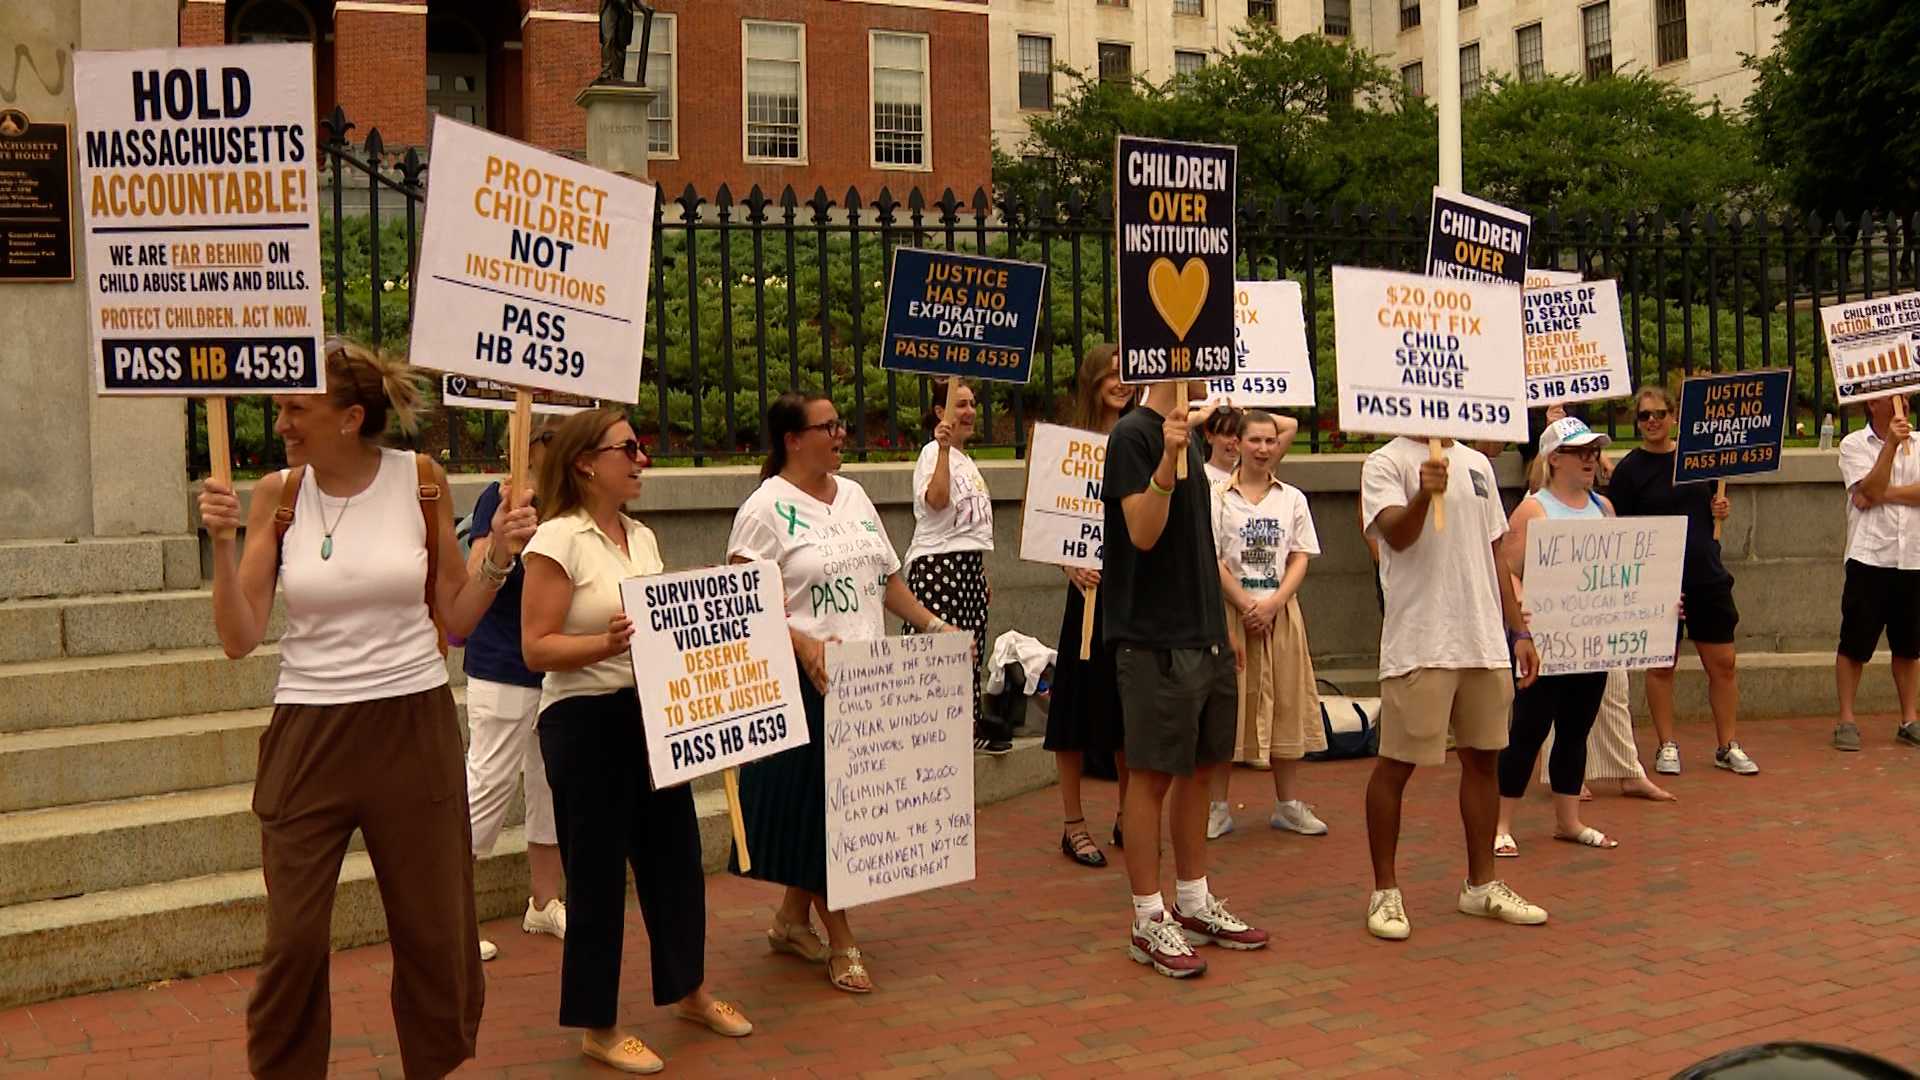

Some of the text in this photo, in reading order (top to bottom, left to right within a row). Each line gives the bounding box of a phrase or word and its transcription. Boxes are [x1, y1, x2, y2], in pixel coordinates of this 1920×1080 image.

[132, 67, 251, 121] HOLD
[86, 125, 304, 168] MASSACHUSETTS
[1128, 151, 1227, 192] CHILDREN
[91, 170, 307, 217] ACCOUNTABLE!
[485, 155, 609, 217] PROTECT
[474, 187, 610, 250] CHILDREN
[1149, 191, 1207, 224] OVER
[1125, 223, 1229, 255] INSTITUTIONS
[1440, 209, 1522, 254] CHILDREN
[110, 242, 289, 266] WE ARE FAR BEHIND ON
[510, 229, 573, 272] NOT
[1455, 241, 1504, 274] OVER
[99, 270, 309, 293] CHILD ABUSE LAWS AND BILLS.
[465, 253, 607, 306] INSTITUTIONS
[925, 263, 1009, 289] JUSTICE
[926, 284, 1006, 311] HAS NO
[1387, 286, 1472, 311] $20,000
[1524, 288, 1596, 308] IVORS OF
[1540, 302, 1597, 320] SEXUAL
[1843, 303, 1891, 320] CHILDREN
[101, 305, 311, 329] PROTECT CHILDREN. ACT NOW.
[502, 303, 566, 343] PASS
[908, 301, 1019, 328] EXPIRATION
[1377, 309, 1482, 336] CAN'T FIX
[1526, 317, 1582, 335] OLENCE
[1877, 315, 1895, 327] NOT
[938, 321, 985, 341] DATE
[1403, 331, 1460, 350] CHILD
[1528, 331, 1580, 348] ESERVE
[115, 345, 304, 380] PASS HB 4539
[475, 332, 585, 378] HB 4539
[895, 340, 1020, 369] PASS HB 4539
[1128, 348, 1166, 377] PASS
[1171, 347, 1190, 373] HB
[1195, 345, 1230, 371] 4539
[1395, 350, 1469, 371] SEXUAL
[1562, 342, 1597, 358] LIMIT
[1402, 370, 1464, 389] ABUSE
[1527, 355, 1608, 376] EEK JUSTICE
[1210, 377, 1287, 393] HB 4539
[1544, 381, 1565, 398] HB
[1570, 375, 1610, 394] 4539
[1706, 381, 1765, 404] JUSTICE
[1357, 396, 1510, 424] PASS HB 4539
[1705, 400, 1763, 419] HAS NO
[1692, 413, 1772, 437] EXPIRATION
[1714, 431, 1748, 447] DATE
[1068, 440, 1105, 462] PRO
[1684, 447, 1773, 471] PASS HB 4539
[1061, 459, 1103, 480] CHIL
[1056, 495, 1104, 514] INSTIT
[1081, 523, 1101, 541] PA
[1063, 540, 1087, 558] HB
[1538, 535, 1566, 566] WE
[1633, 531, 1658, 559] BE
[645, 570, 761, 608] SURVIVORS OF
[1577, 563, 1646, 592] SILENT
[811, 577, 859, 618] PASS
[1534, 591, 1639, 614] SO YOU CAN BE
[650, 593, 764, 632] CHILD SEXUAL
[673, 617, 751, 652] VIOLENCE
[870, 635, 934, 658] HB 4539
[1535, 629, 1649, 659] PASS HB 4539
[684, 642, 751, 674] DESERVE
[841, 652, 968, 682] ELIMINATE THE STATUTE
[668, 659, 769, 702] NO TIME LIMIT
[854, 676, 915, 695] LIMITATIONS
[919, 672, 941, 686] FOR
[664, 680, 782, 728] TO SEEK JUSTICE
[839, 684, 964, 714] CHILD SEXUAL ABUSE
[854, 719, 885, 739] YEAR
[889, 710, 938, 730] WINDOW
[946, 705, 964, 720] FOR
[671, 713, 788, 770] PASS HB 4539
[848, 729, 947, 760] SURVIVORS DENIED
[845, 759, 887, 778] JUSTICE
[841, 765, 959, 806] ELIMINATE $20,000
[845, 787, 951, 822] CAP ON DAMAGES
[843, 813, 973, 854] REMOVAL THE 3 YEAR
[847, 834, 969, 874] GOVERNMENT NOTICE
[868, 856, 950, 886] REQUIREMENT
